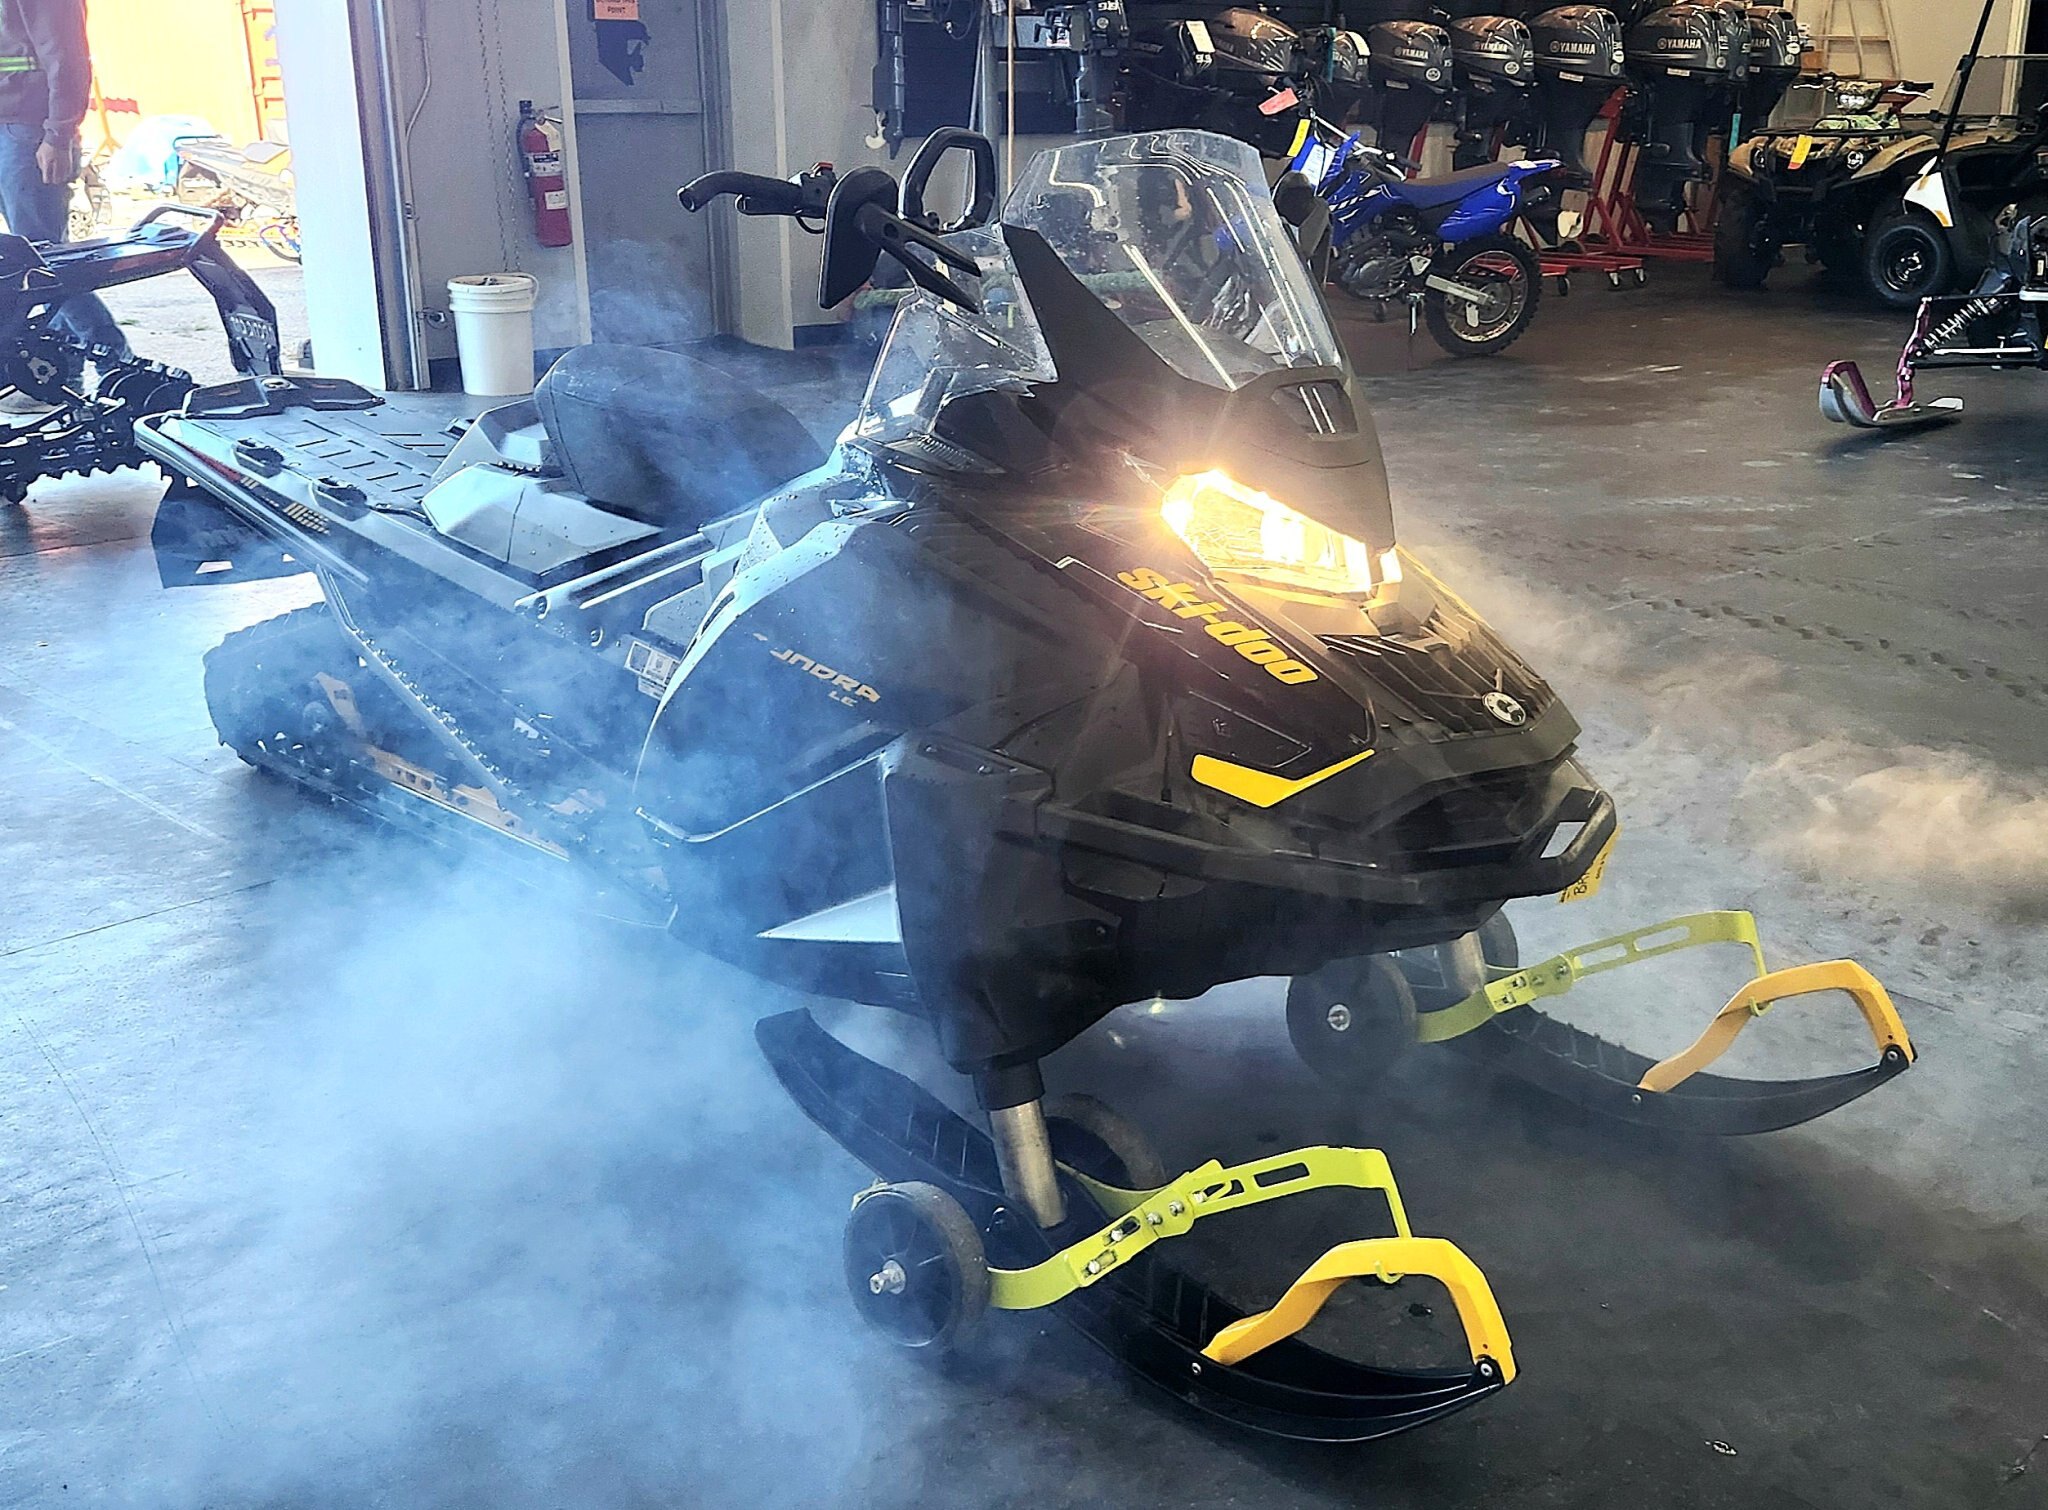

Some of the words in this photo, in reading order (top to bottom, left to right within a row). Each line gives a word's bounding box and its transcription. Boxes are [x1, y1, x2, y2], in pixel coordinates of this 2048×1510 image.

[1481, 42, 1508, 53] YAMAHA
[1560, 42, 1596, 55] YAMAHA
[1667, 38, 1702, 50] YAMAHA
[1402, 48, 1429, 60] YAMAHA
